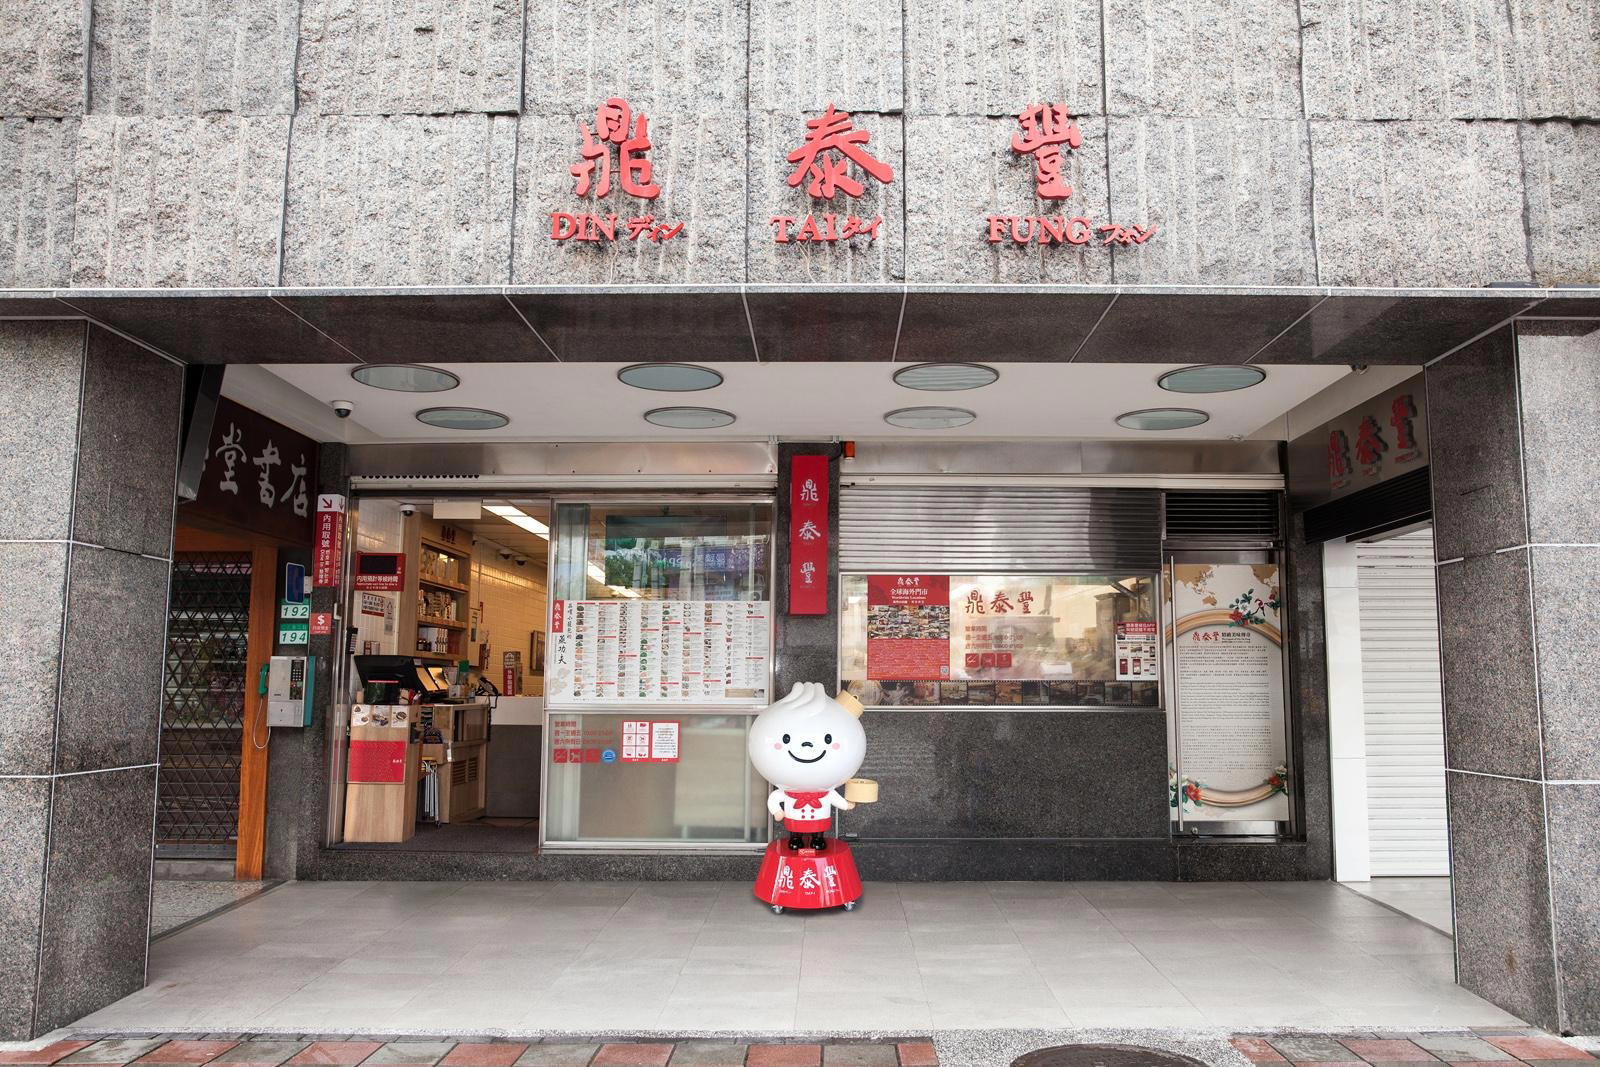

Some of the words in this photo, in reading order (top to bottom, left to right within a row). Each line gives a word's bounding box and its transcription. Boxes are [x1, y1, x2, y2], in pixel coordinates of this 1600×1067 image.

[570, 98, 660, 199] 鼎
[787, 103, 894, 199] 泰
[550, 213, 617, 240] DIN
[627, 214, 684, 242] ディン
[770, 212, 838, 243] TAI
[843, 214, 882, 240] タイ
[987, 215, 1092, 245] FUNG
[283, 606, 308, 617] 192
[965, 590, 1034, 614] 鼎泰豐
[282, 632, 306, 642] 194
